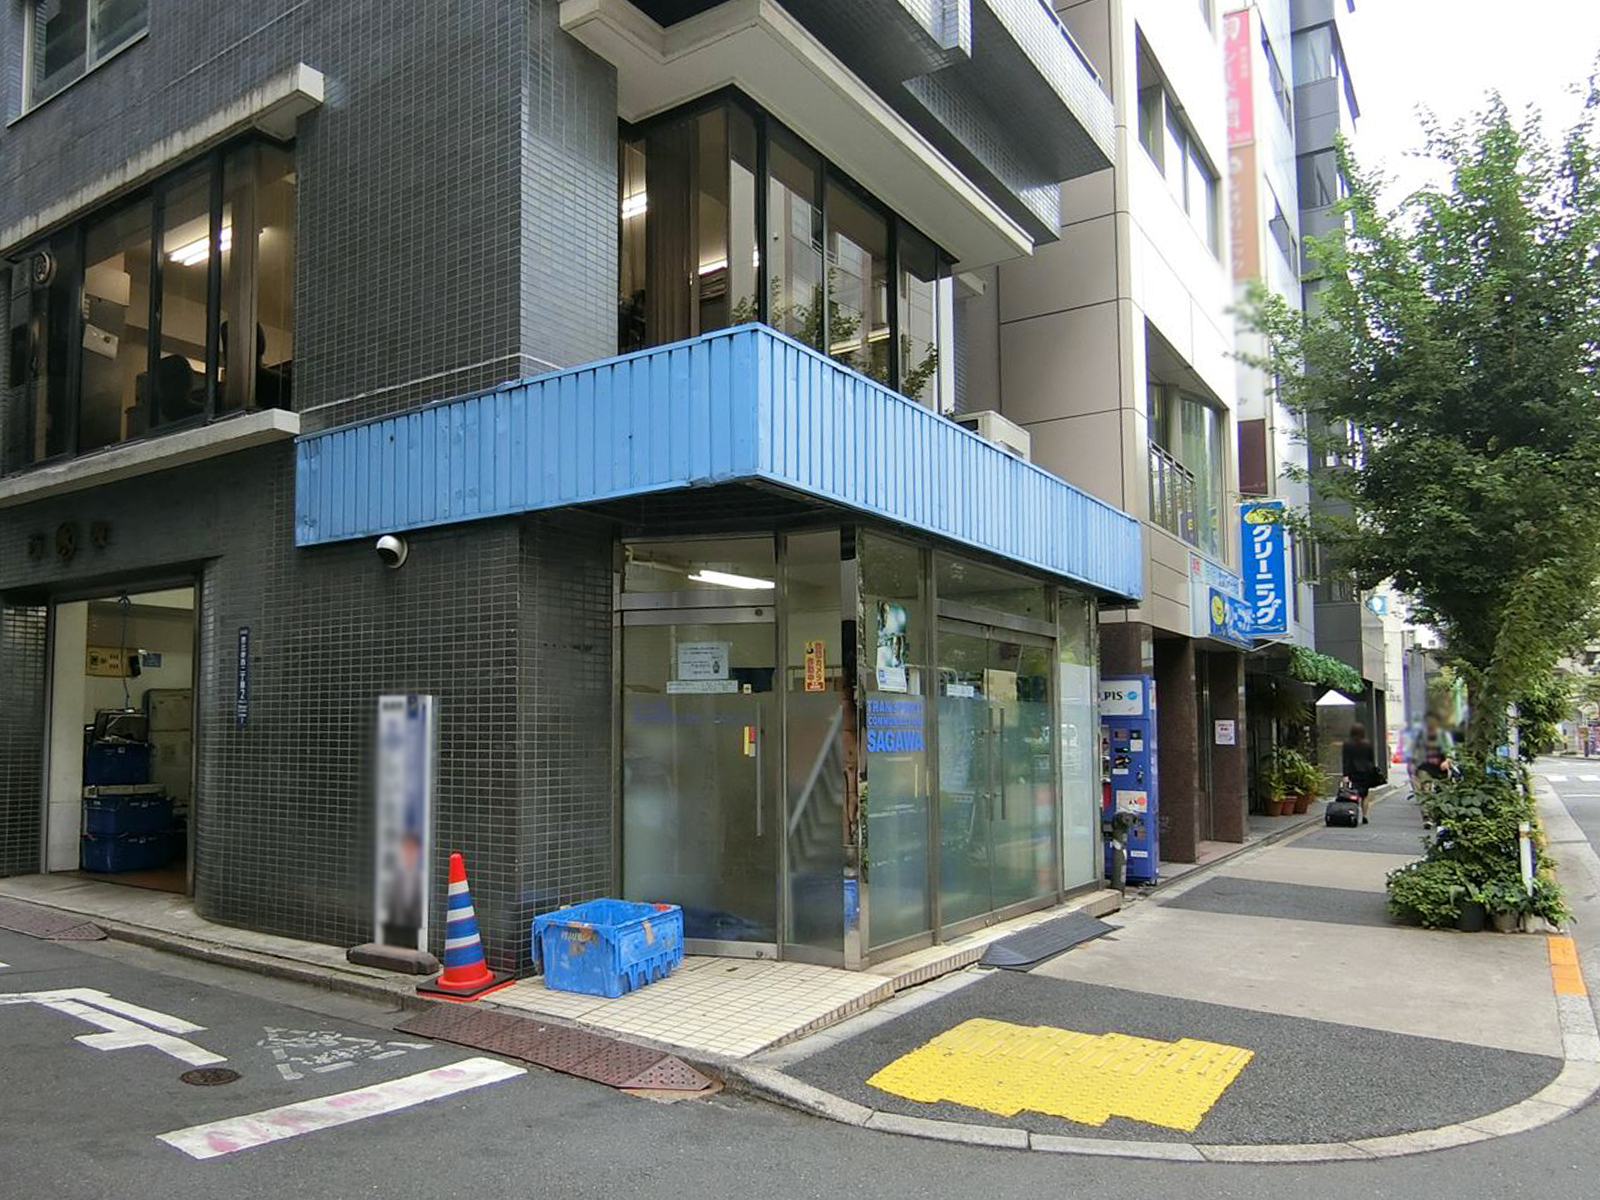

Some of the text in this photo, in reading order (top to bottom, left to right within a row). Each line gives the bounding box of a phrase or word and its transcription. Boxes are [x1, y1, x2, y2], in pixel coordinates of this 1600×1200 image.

[1252, 525, 1282, 625] クリーニング
[1101, 691, 1123, 701] PIS
[867, 729, 924, 752] SAGAWA
